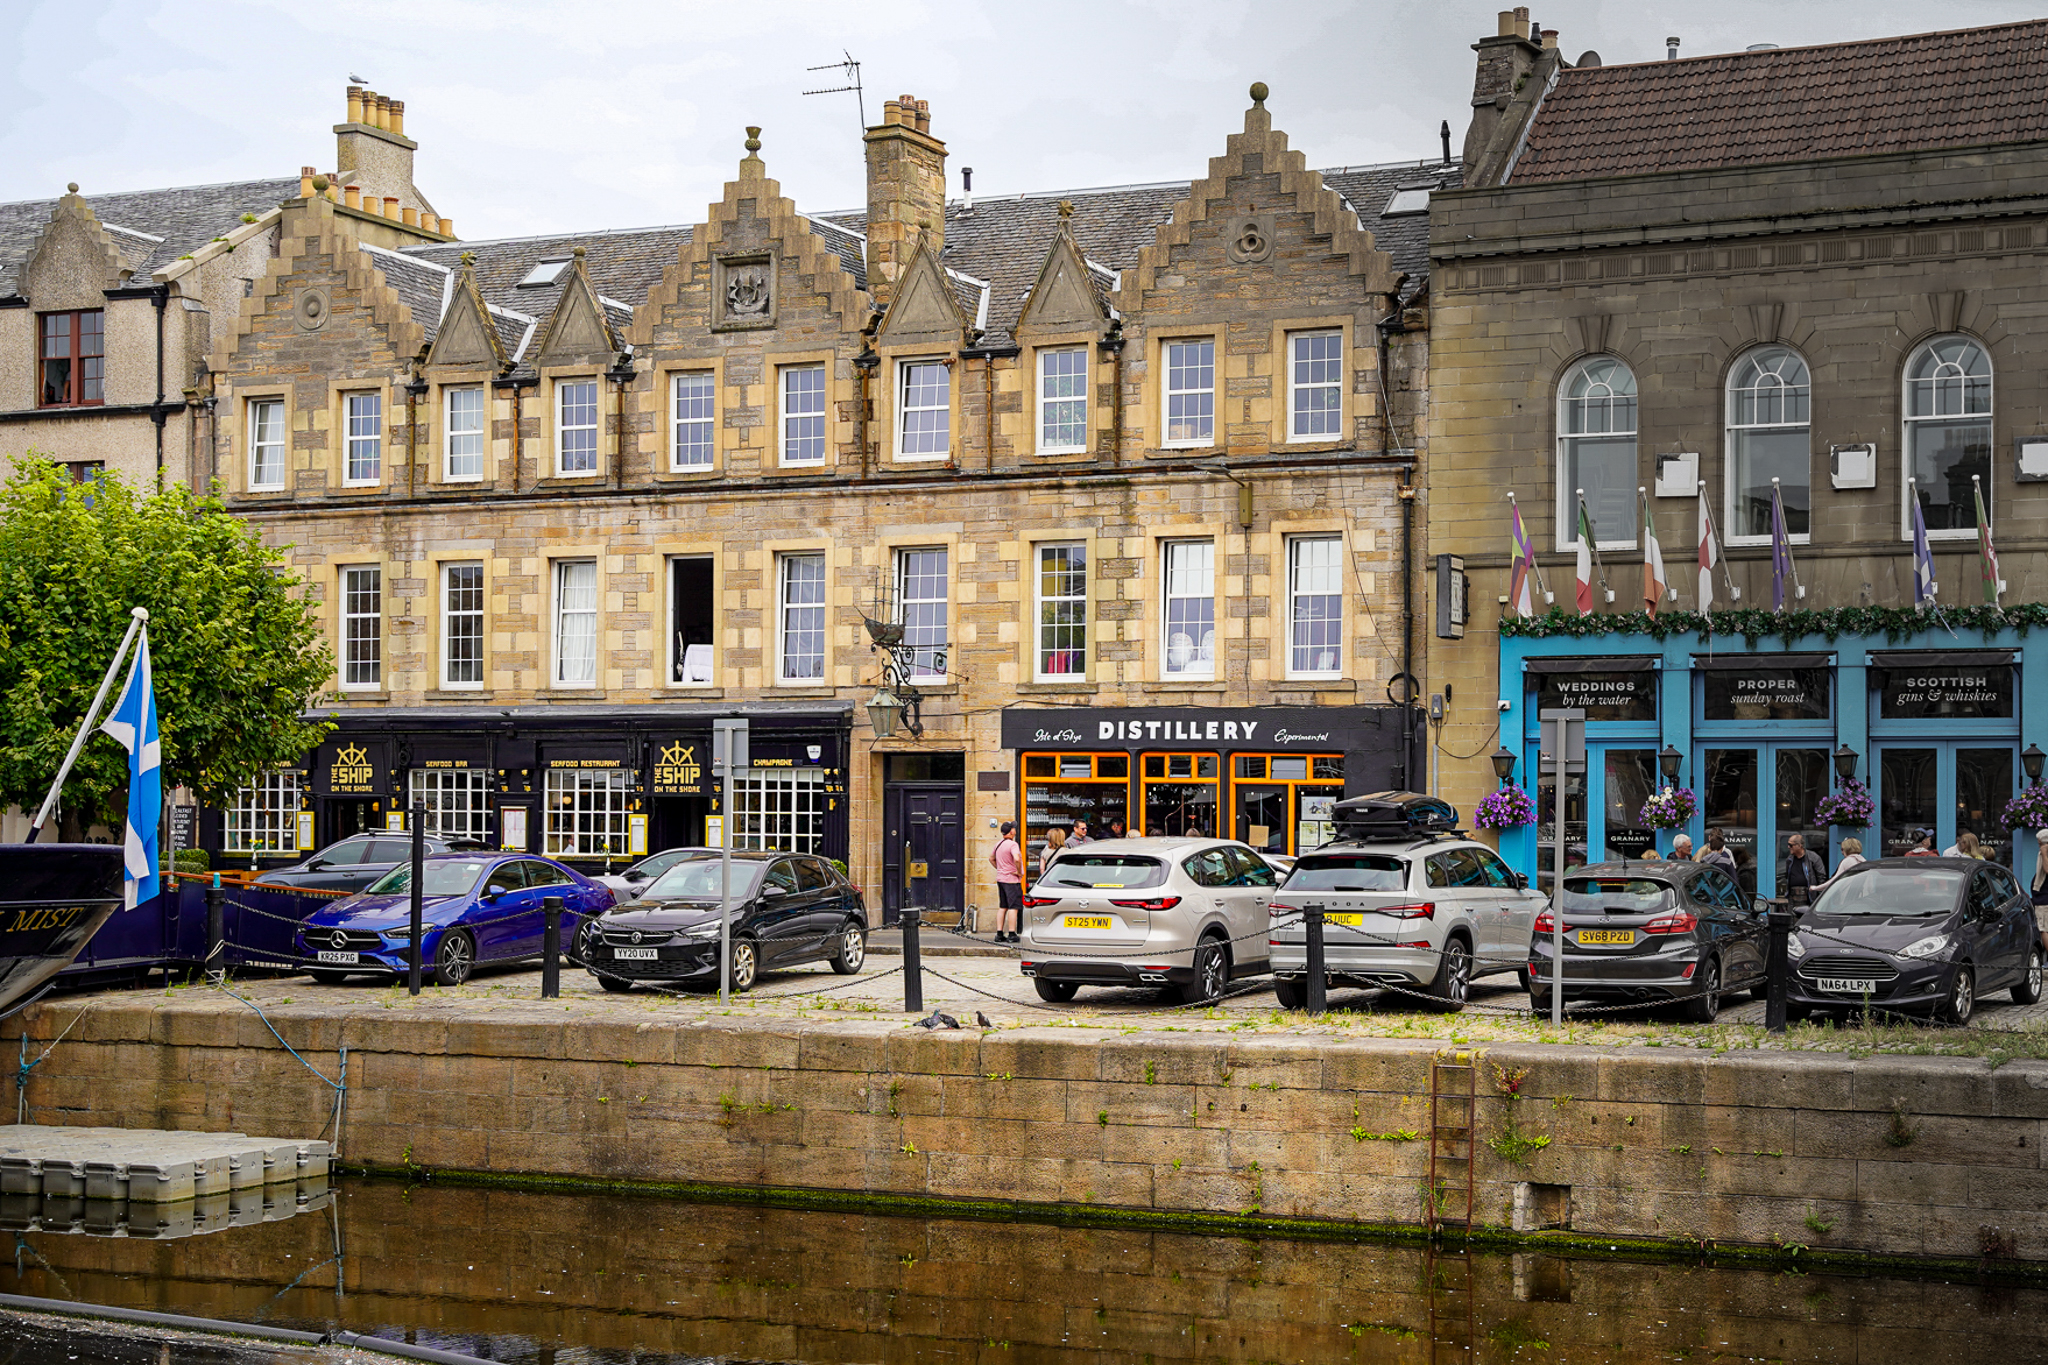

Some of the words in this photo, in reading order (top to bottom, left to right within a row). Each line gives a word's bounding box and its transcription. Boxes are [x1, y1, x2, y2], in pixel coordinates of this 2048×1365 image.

[1557, 682, 1635, 692] WEDDINGS
[1738, 680, 1796, 689] PROPER
[1906, 677, 1986, 687] SCOTTISH
[1562, 694, 1576, 708] by
[1578, 694, 1595, 706] the
[1598, 696, 1631, 706] water
[1730, 691, 1772, 707] sunday
[1775, 692, 1805, 704] roast
[1896, 689, 1924, 706] gins
[1928, 689, 1942, 701] &
[1945, 689, 1997, 701] whiskies
[1033, 729, 1051, 742] Isle
[1053, 730, 1060, 741] of
[1062, 729, 1082, 742] Skye
[1099, 721, 1258, 740] DISTILLERY
[1274, 729, 1329, 744] Experimental
[339, 767, 373, 784] SHIP
[654, 767, 662, 784] THE
[663, 767, 701, 784] SHIP
[6, 907, 84, 932] MIST
[1067, 917, 1089, 926] ST25
[1092, 918, 1109, 927] YWN
[1582, 931, 1608, 941] SV68
[1610, 931, 1630, 941] PZD
[340, 953, 355, 962] PXG
[618, 949, 638, 957] YY20
[639, 949, 655, 957] UVX
[1821, 980, 1848, 990] NA64
